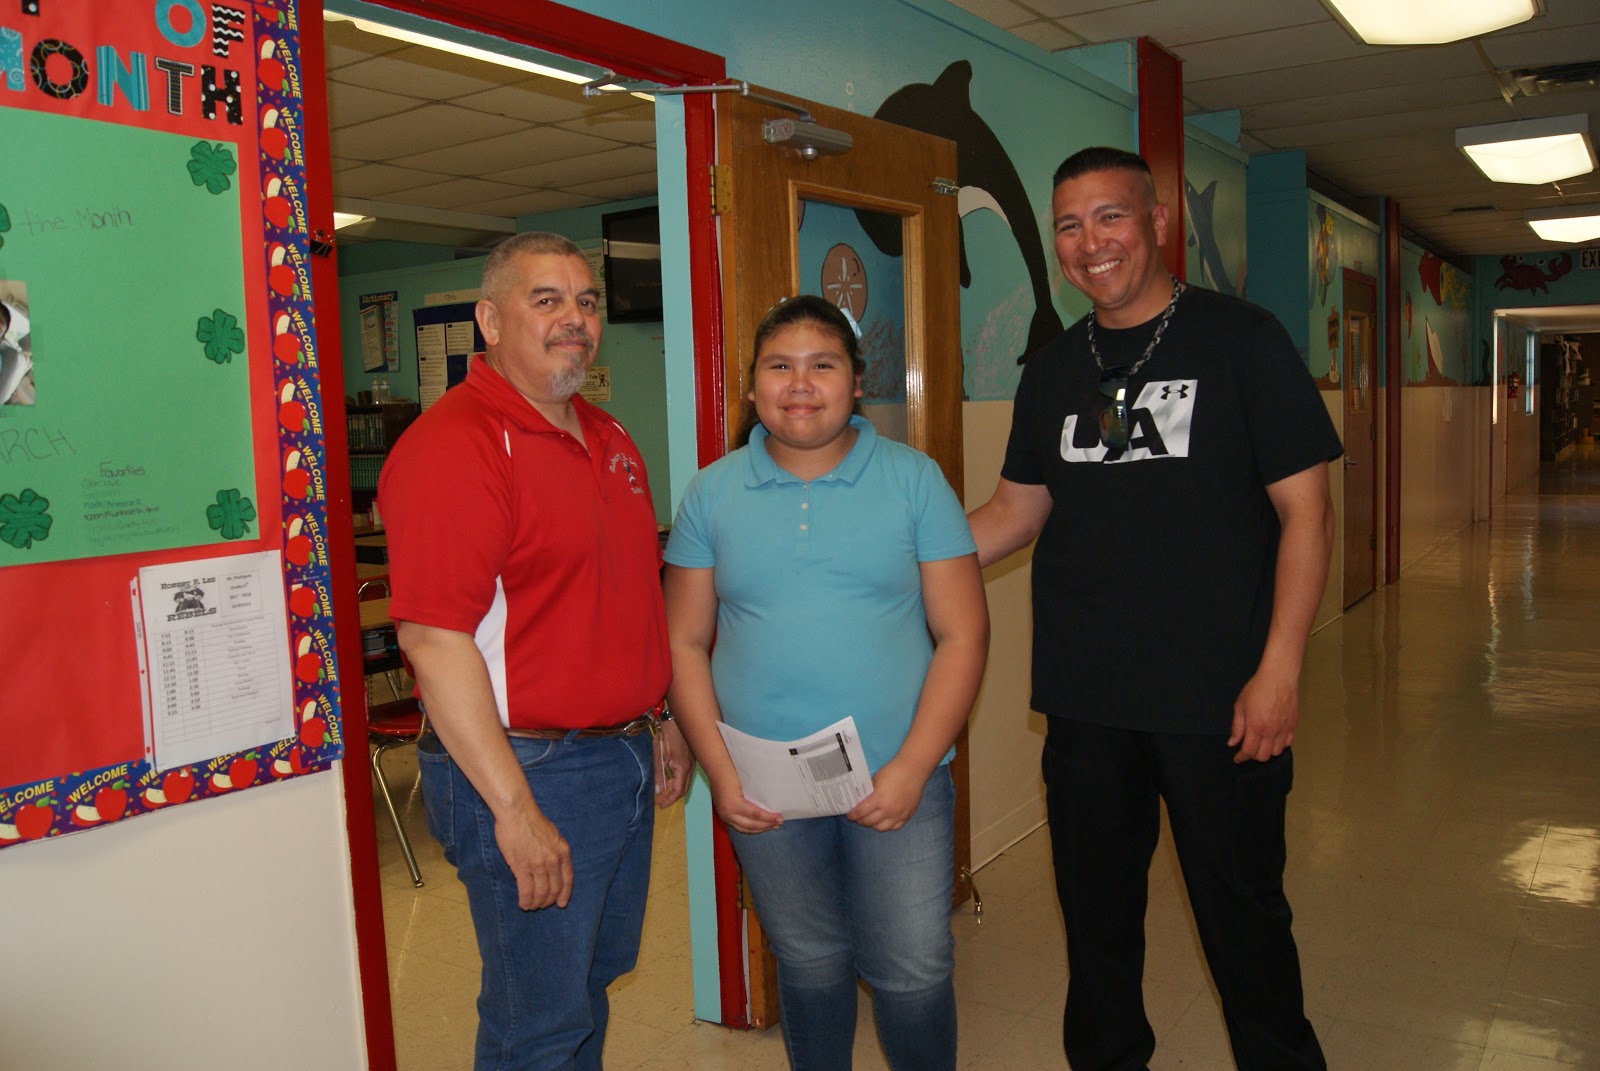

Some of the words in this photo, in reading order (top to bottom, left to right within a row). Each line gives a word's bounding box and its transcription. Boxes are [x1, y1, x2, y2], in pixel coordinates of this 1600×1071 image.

[155, 0, 245, 58] OF
[277, 38, 301, 99] WELCOME
[280, 106, 304, 167] WELCOME
[17, 208, 64, 237] the
[75, 200, 132, 230] Month
[283, 175, 307, 234] WELCOME
[287, 243, 312, 301] WELCOME
[361, 292, 396, 304] Dictionary
[291, 311, 317, 369] WELCOME
[296, 378, 322, 435] WELCOME
[302, 445, 326, 501] WELCOME
[304, 512, 328, 566] WELCOME
[166, 607, 217, 622] REBELS
[313, 629, 337, 682] WELCOME
[269, 736, 299, 757] WELC
[318, 694, 342, 746] WELCOME
[69, 764, 128, 804] WELCOME
